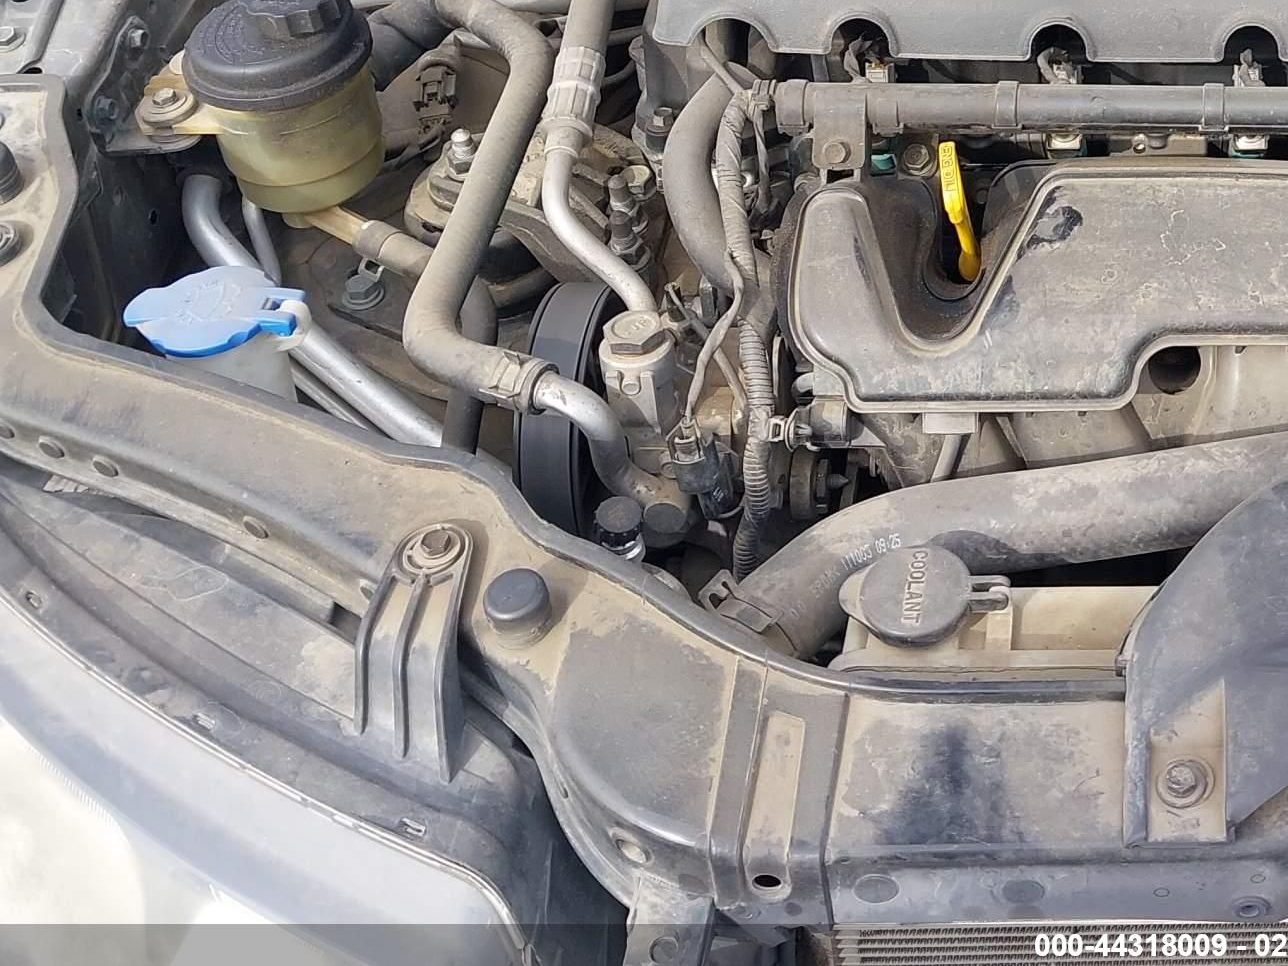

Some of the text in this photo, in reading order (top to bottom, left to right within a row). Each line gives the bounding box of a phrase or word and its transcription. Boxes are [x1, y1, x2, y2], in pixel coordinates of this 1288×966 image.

[941, 146, 956, 192] ENG OIL
[900, 550, 929, 626] COOLANT
